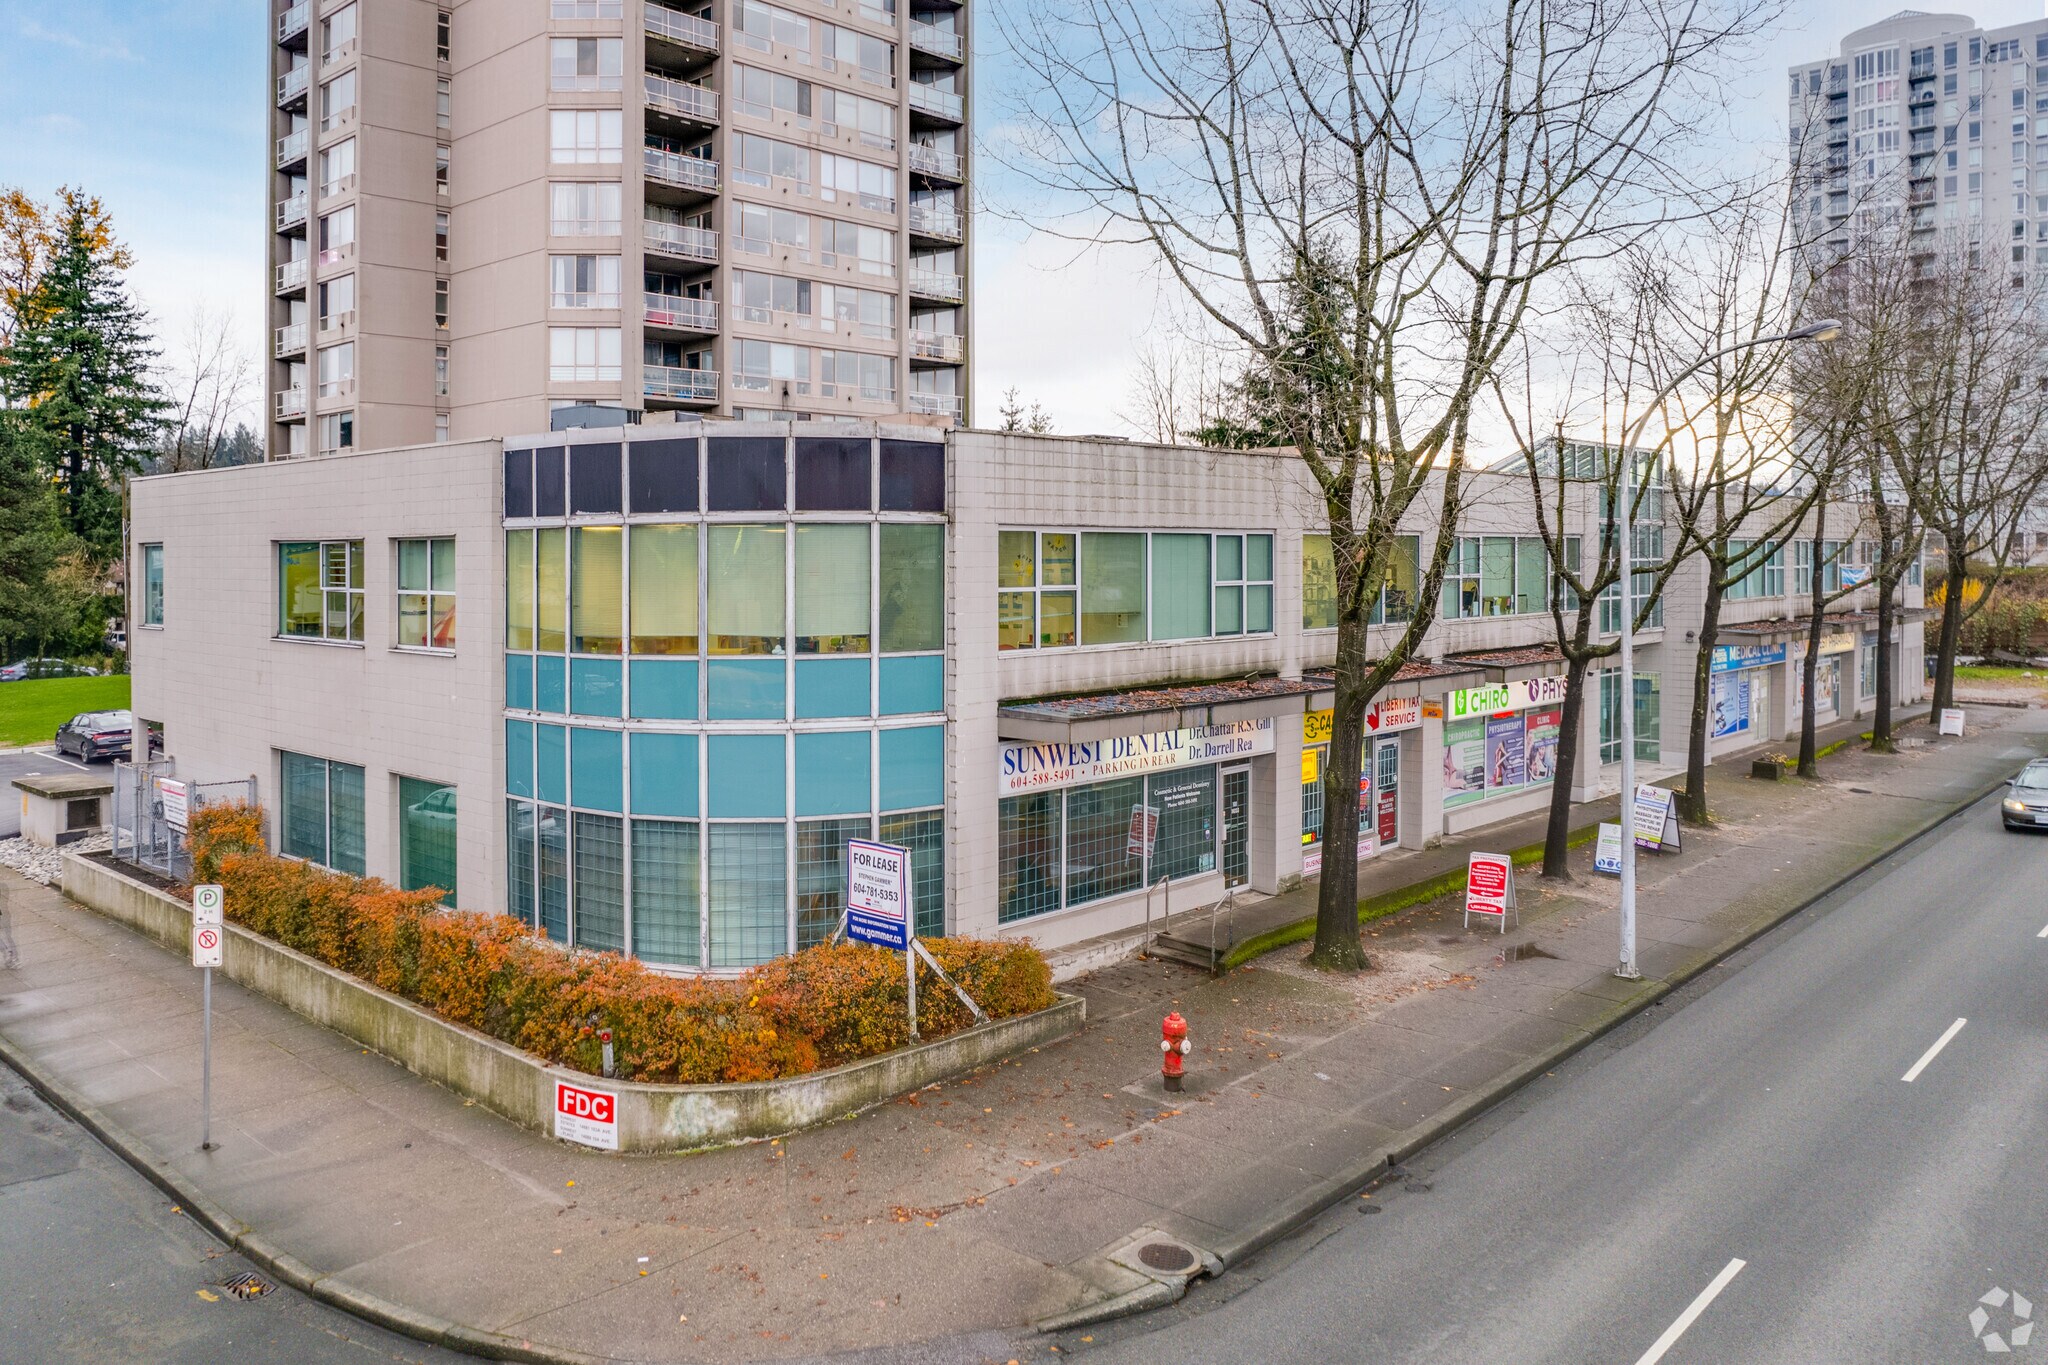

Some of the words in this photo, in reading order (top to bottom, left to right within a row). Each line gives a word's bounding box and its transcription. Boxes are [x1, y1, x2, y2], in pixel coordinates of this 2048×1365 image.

[1729, 645, 1761, 662] MEDICAL
[1762, 643, 1783, 656] CLINIC
[1381, 698, 1406, 712] LIBERTY
[1408, 696, 1420, 708] TAX
[1471, 688, 1509, 712] CHIRO
[1256, 717, 1271, 730] Gill
[1386, 712, 1416, 726] SERVICE
[1488, 720, 1522, 734] PHYSIOTHERAPY
[1537, 715, 1550, 725] CLINIC
[1448, 728, 1480, 743] CHIROPRACTIC
[1004, 741, 1103, 776] SUNWEST
[1112, 730, 1185, 759] DENTAL
[1188, 745, 1202, 760] Dr.
[1205, 740, 1234, 757] Darrell
[1237, 738, 1252, 752] Rea
[1093, 758, 1136, 776] PARKING
[1139, 757, 1150, 770] IN
[1152, 753, 1176, 767] REAR
[1010, 769, 1076, 789] 604-588-5491
[854, 853, 871, 867] FOR
[872, 856, 898, 872] LEASE
[854, 882, 898, 902] 604-781-5353
[851, 924, 902, 944] www.gammer.ca
[563, 1089, 608, 1120] FDC
